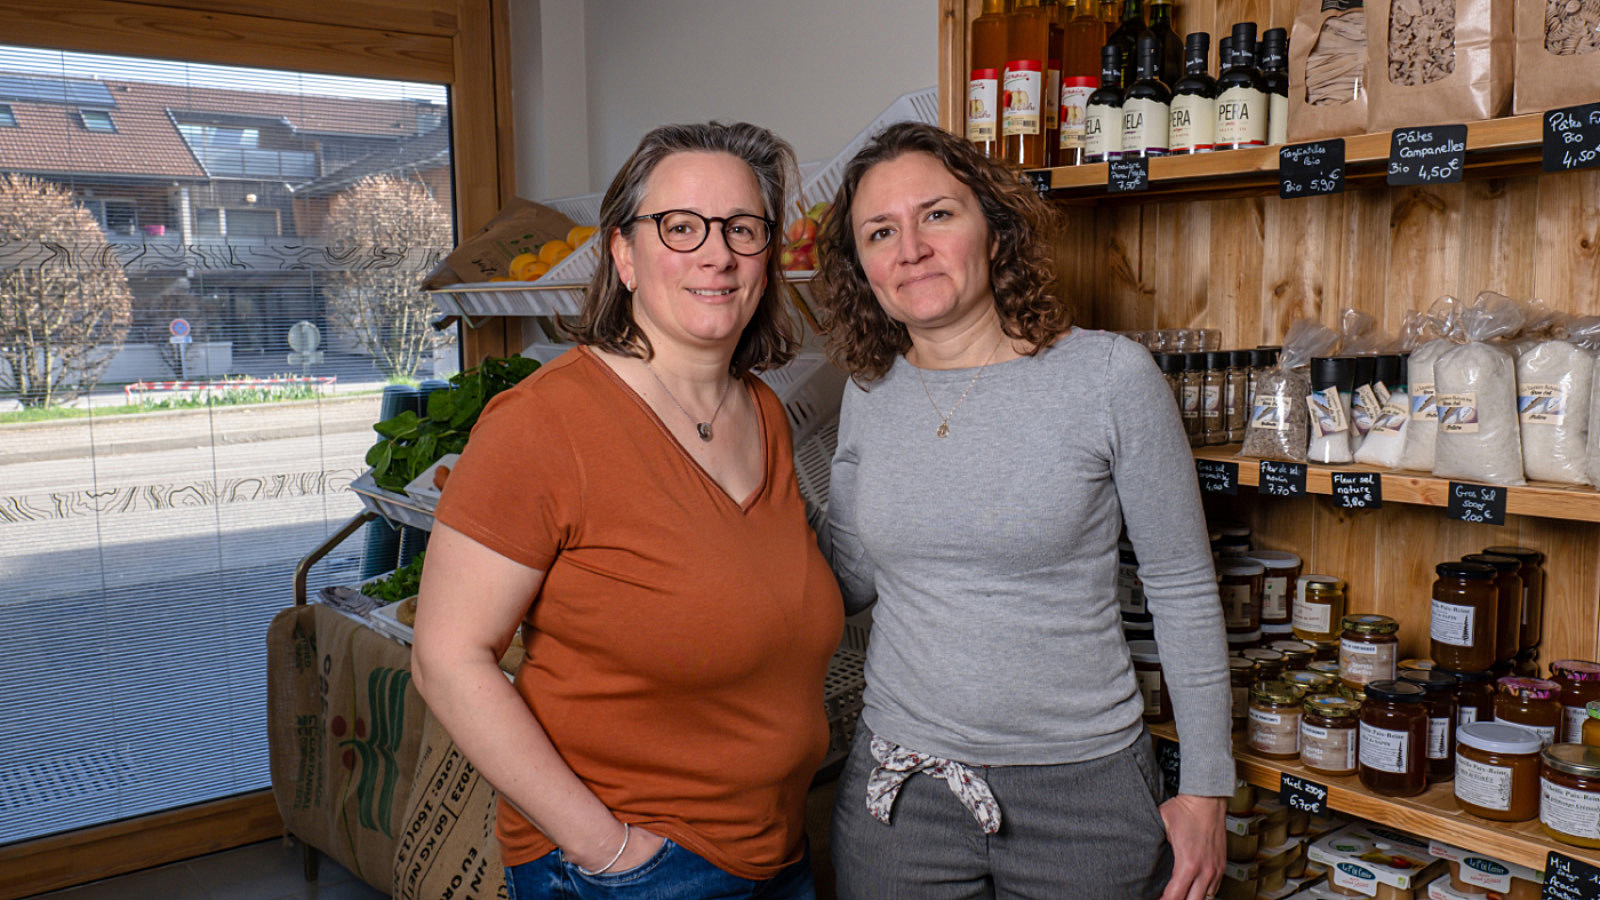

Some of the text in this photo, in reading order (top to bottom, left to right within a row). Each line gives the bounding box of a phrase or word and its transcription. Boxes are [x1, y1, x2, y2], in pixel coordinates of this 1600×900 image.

[1218, 103, 1249, 121] PERA
[1589, 110, 1600, 125] Fu
[1396, 130, 1433, 146] Pâtes
[1400, 138, 1464, 158] Campanelles
[1418, 158, 1459, 180] 4,50€
[1283, 180, 1303, 193] Bio
[1334, 474, 1357, 485] Fleur
[1267, 483, 1299, 496] 7,70€
[1337, 485, 1372, 494] nature
[1455, 485, 1478, 498] Gros
[431, 750, 459, 797] Lote:
[451, 762, 475, 802] 2023
[1290, 793, 1320, 813] 6,70€
[434, 814, 449, 836] 60
[420, 837, 436, 862] KG
[440, 846, 478, 900] EU OR
[1550, 856, 1570, 873] Miel
